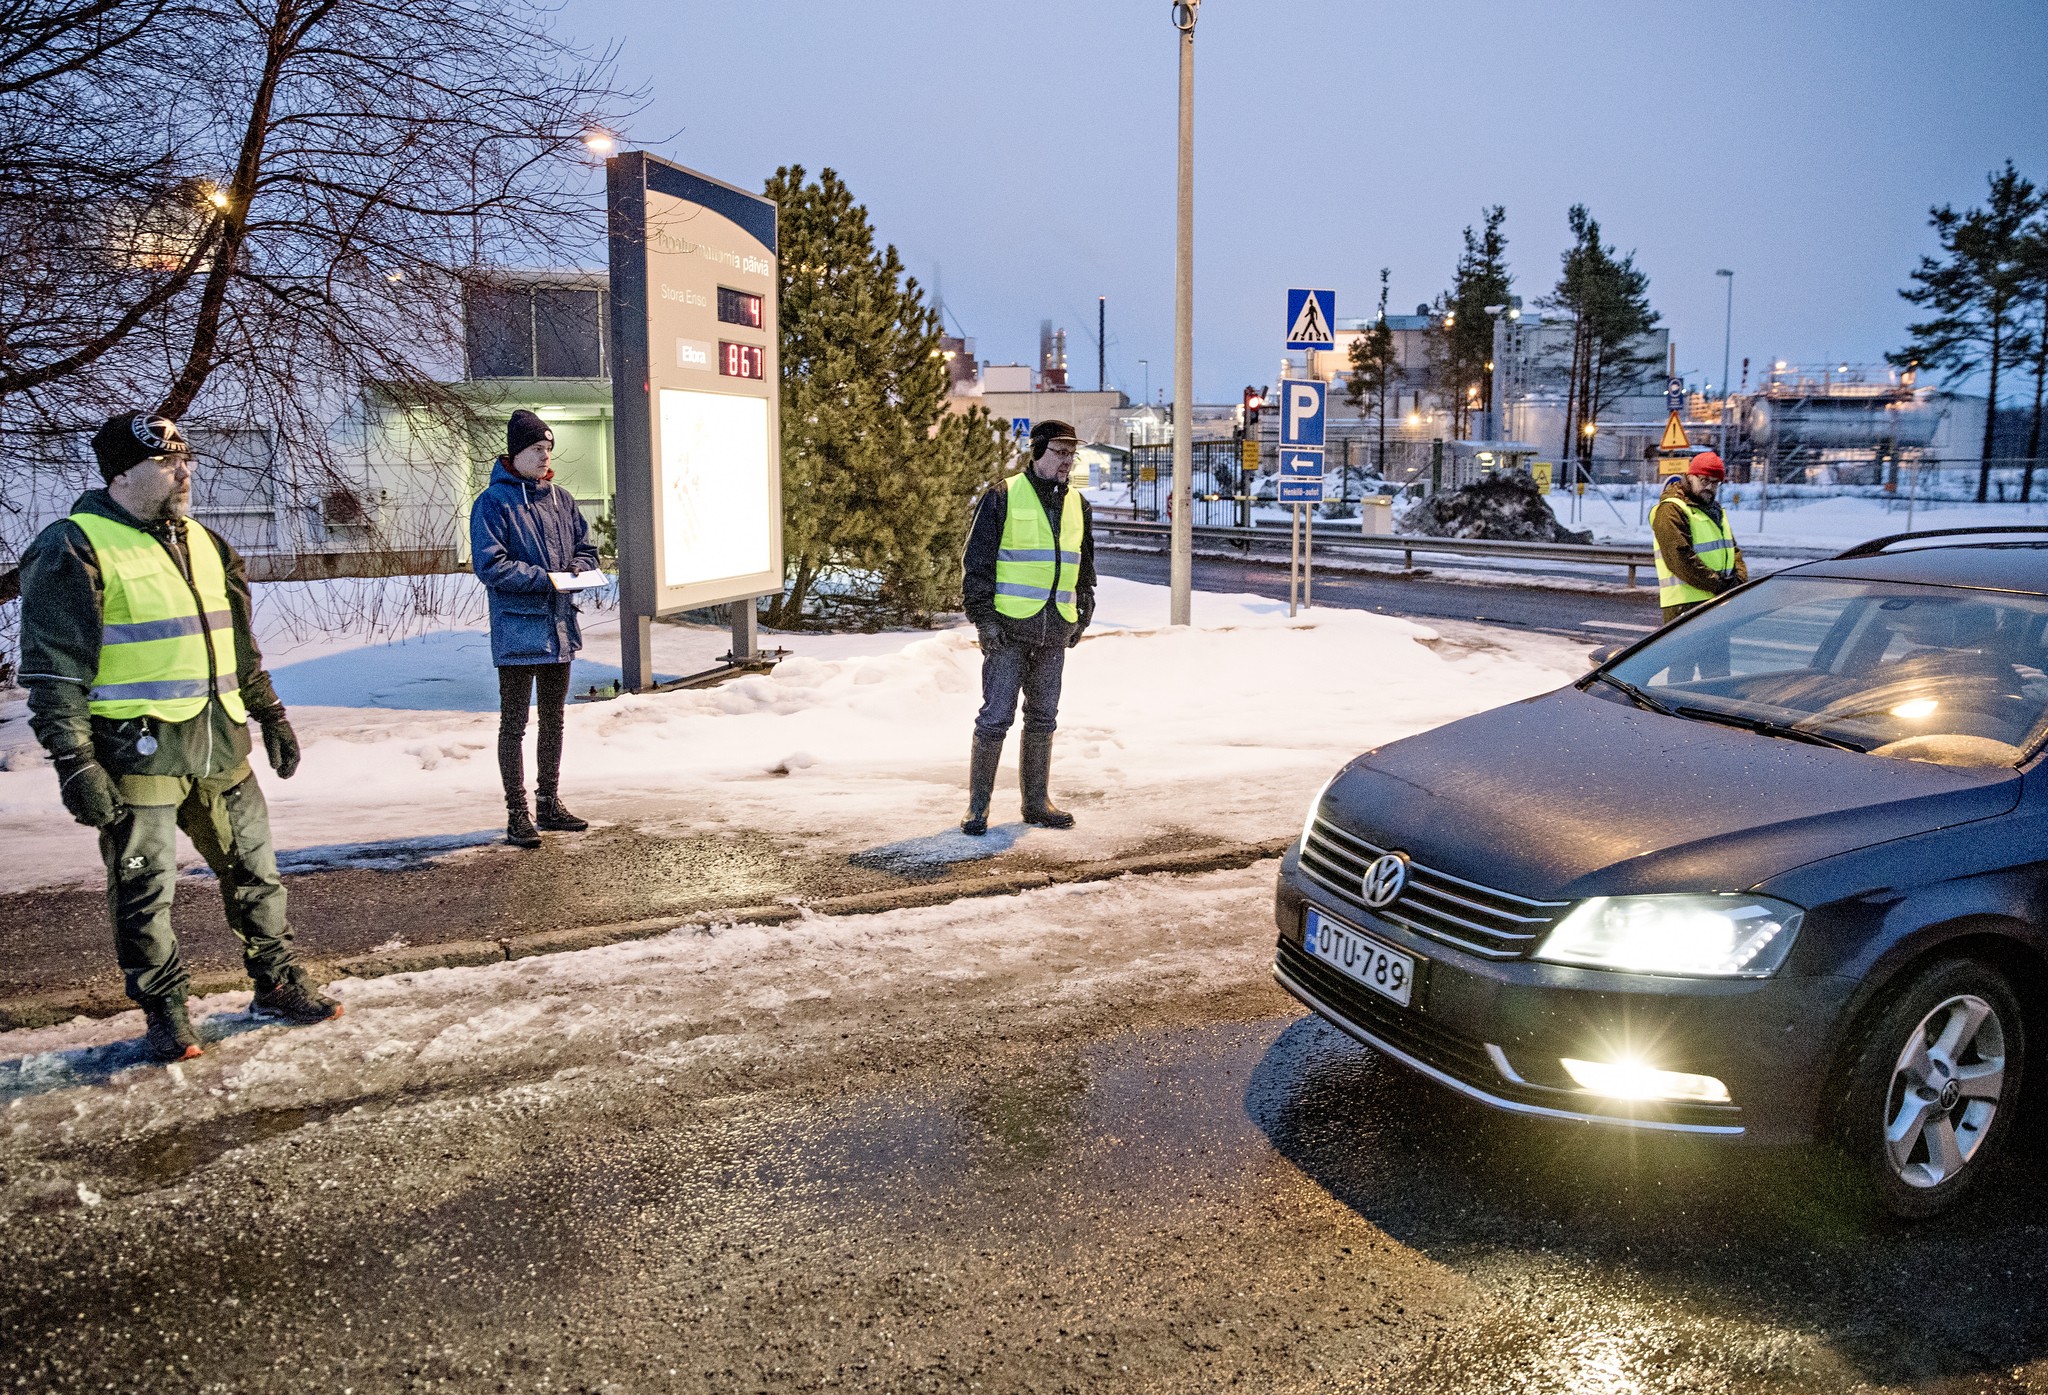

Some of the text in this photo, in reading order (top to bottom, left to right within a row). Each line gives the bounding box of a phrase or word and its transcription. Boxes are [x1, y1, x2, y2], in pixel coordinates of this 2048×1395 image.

[743, 255, 769, 277] päiviä
[660, 283, 707, 308] Stora Enso
[750, 298, 760, 326] 4
[728, 344, 762, 377] 867
[1289, 384, 1320, 441] P
[1320, 924, 1405, 991] OTU-789
